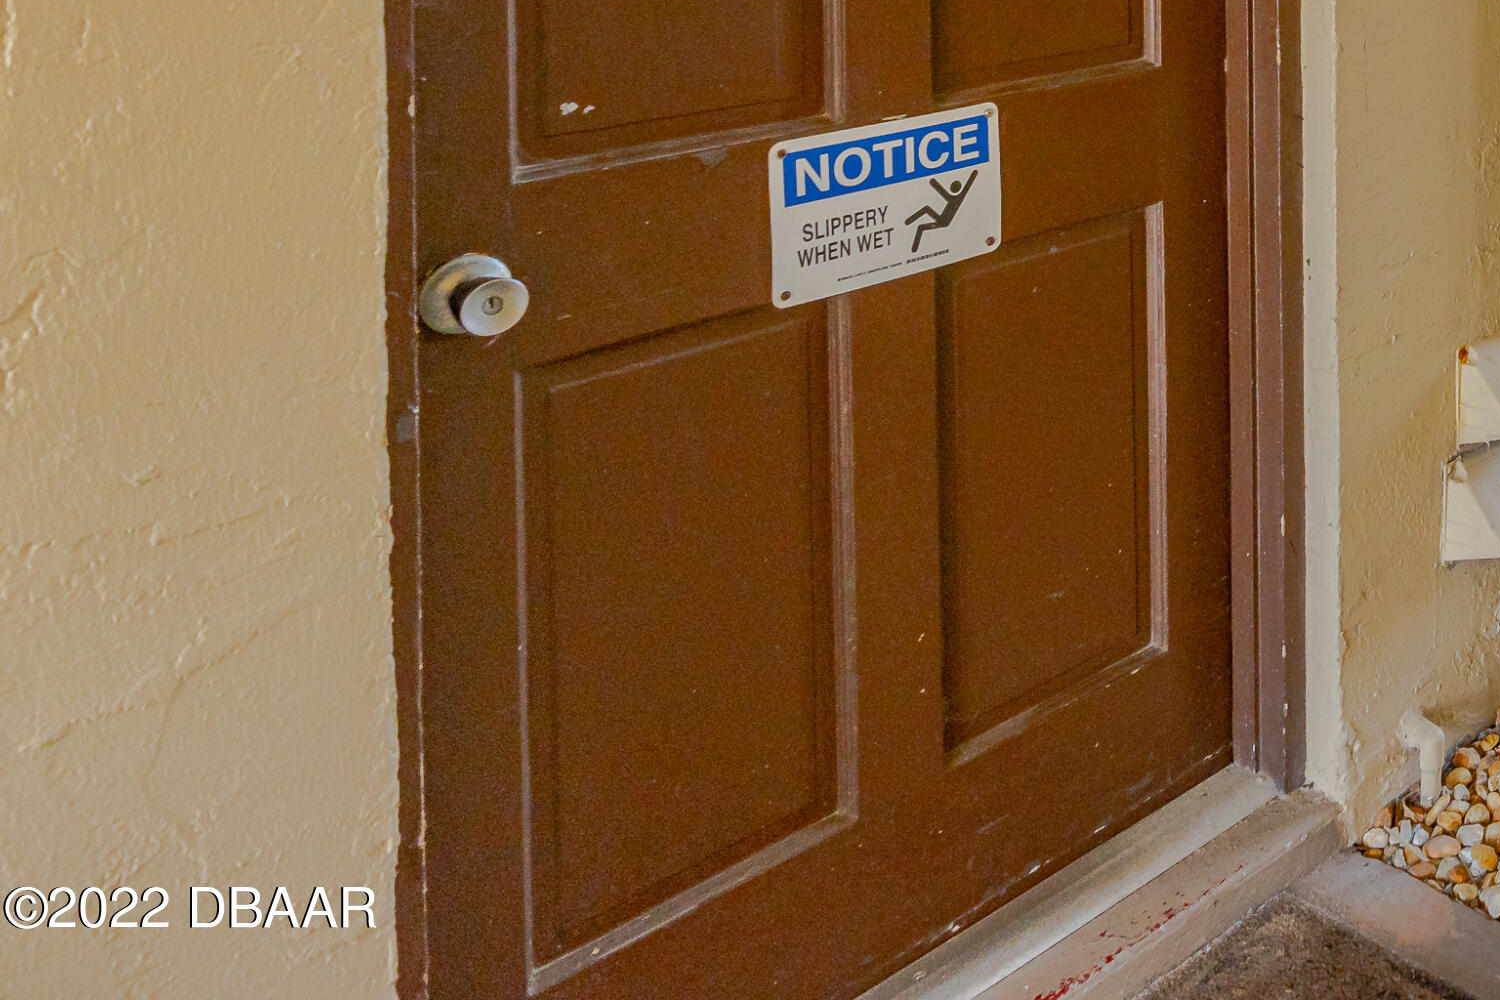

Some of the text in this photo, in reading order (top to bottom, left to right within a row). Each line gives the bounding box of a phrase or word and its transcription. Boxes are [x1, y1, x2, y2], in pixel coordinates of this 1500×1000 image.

[795, 123, 980, 198] NOTICE
[802, 205, 889, 242] SLIPPERY
[797, 238, 852, 268] WHEN
[856, 227, 895, 254] WET
